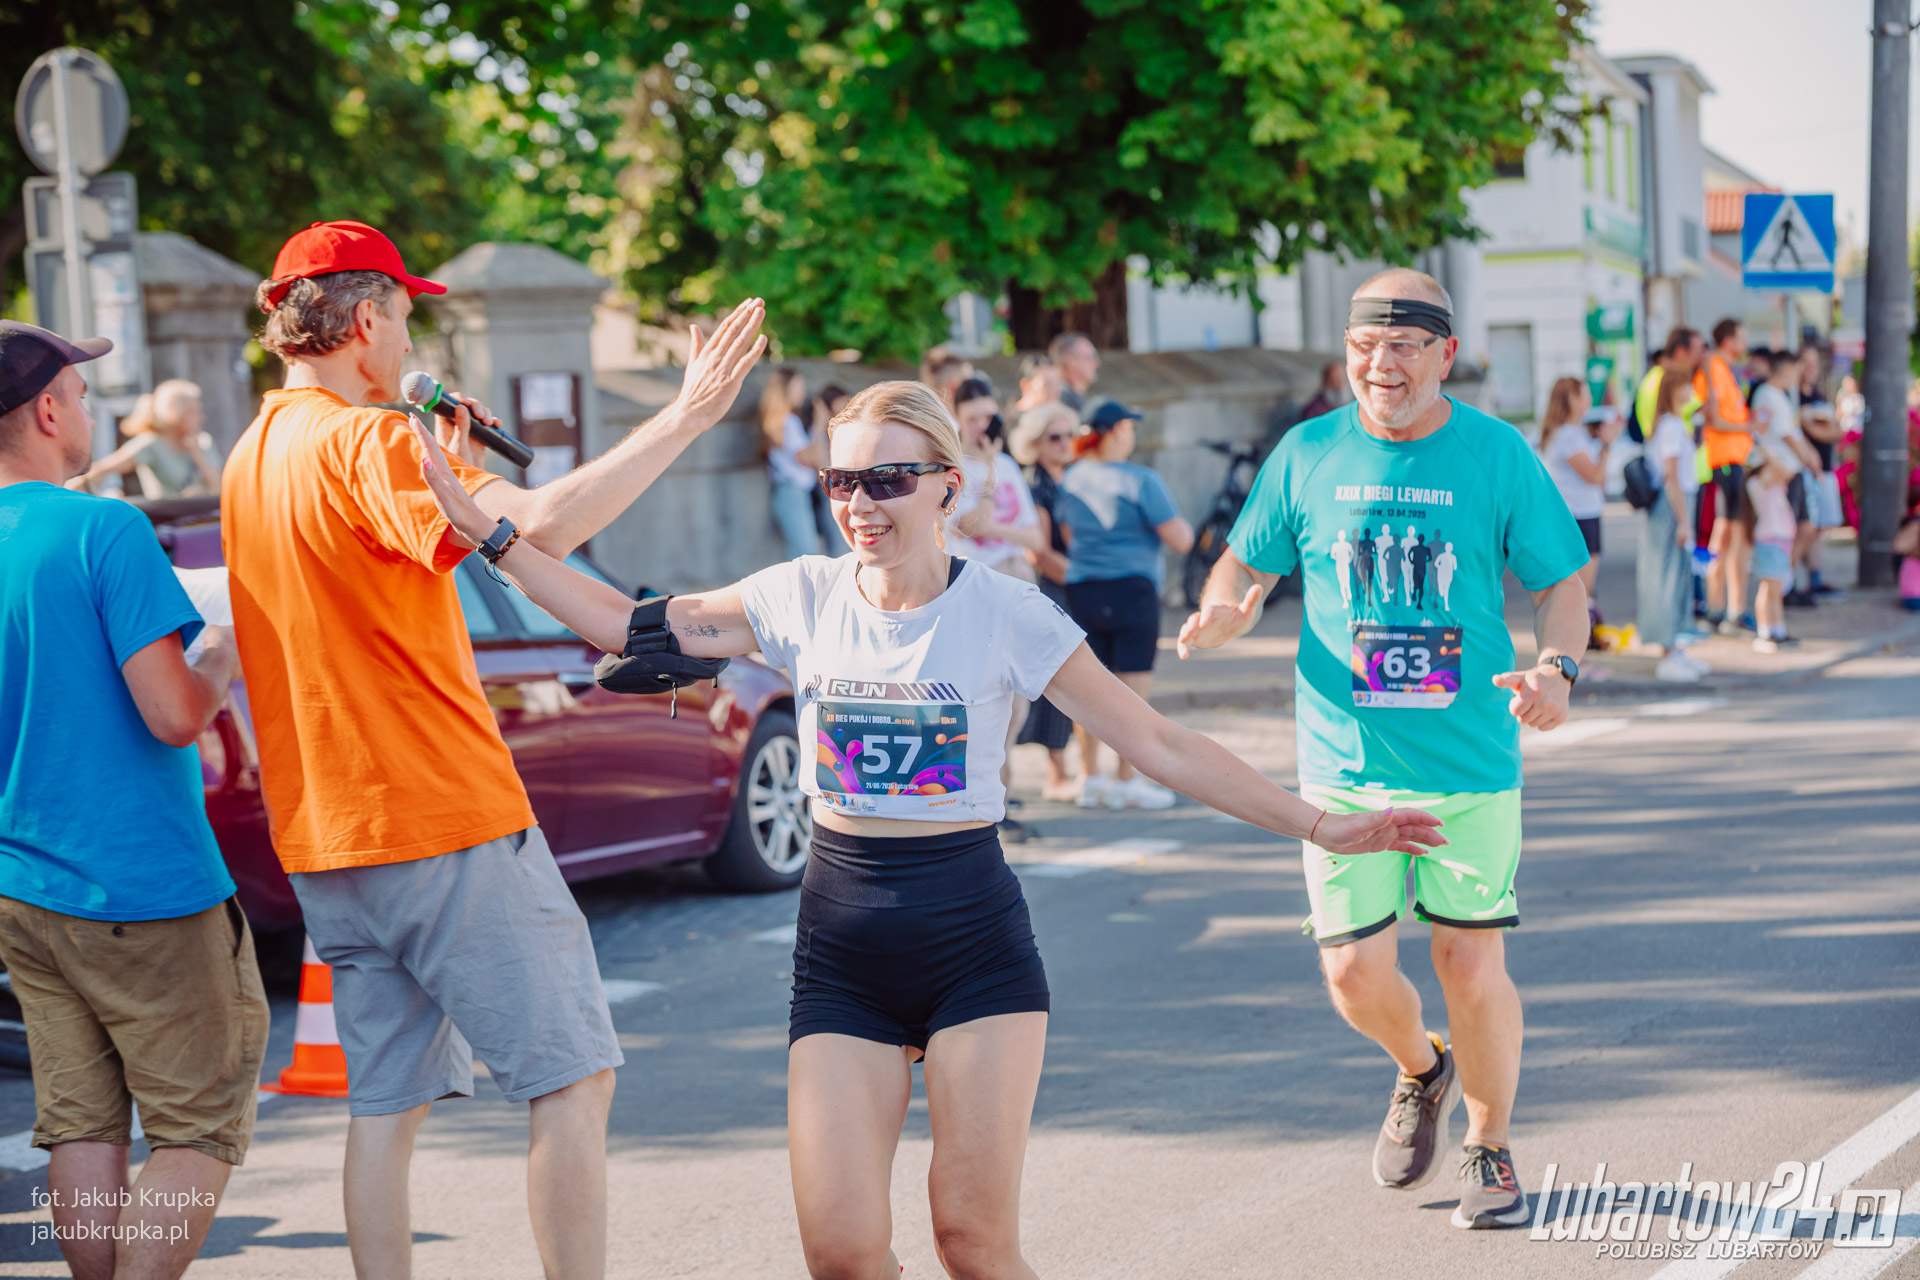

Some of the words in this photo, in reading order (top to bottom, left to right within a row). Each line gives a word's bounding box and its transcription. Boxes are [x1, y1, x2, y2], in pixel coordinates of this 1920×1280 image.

[1335, 485, 1360, 501] XXIX
[1364, 486, 1393, 502] BIEGI
[1397, 487, 1453, 506] LEWARTA
[1383, 647, 1431, 679] 63
[830, 679, 887, 698] RUN
[862, 734, 922, 775] 57
